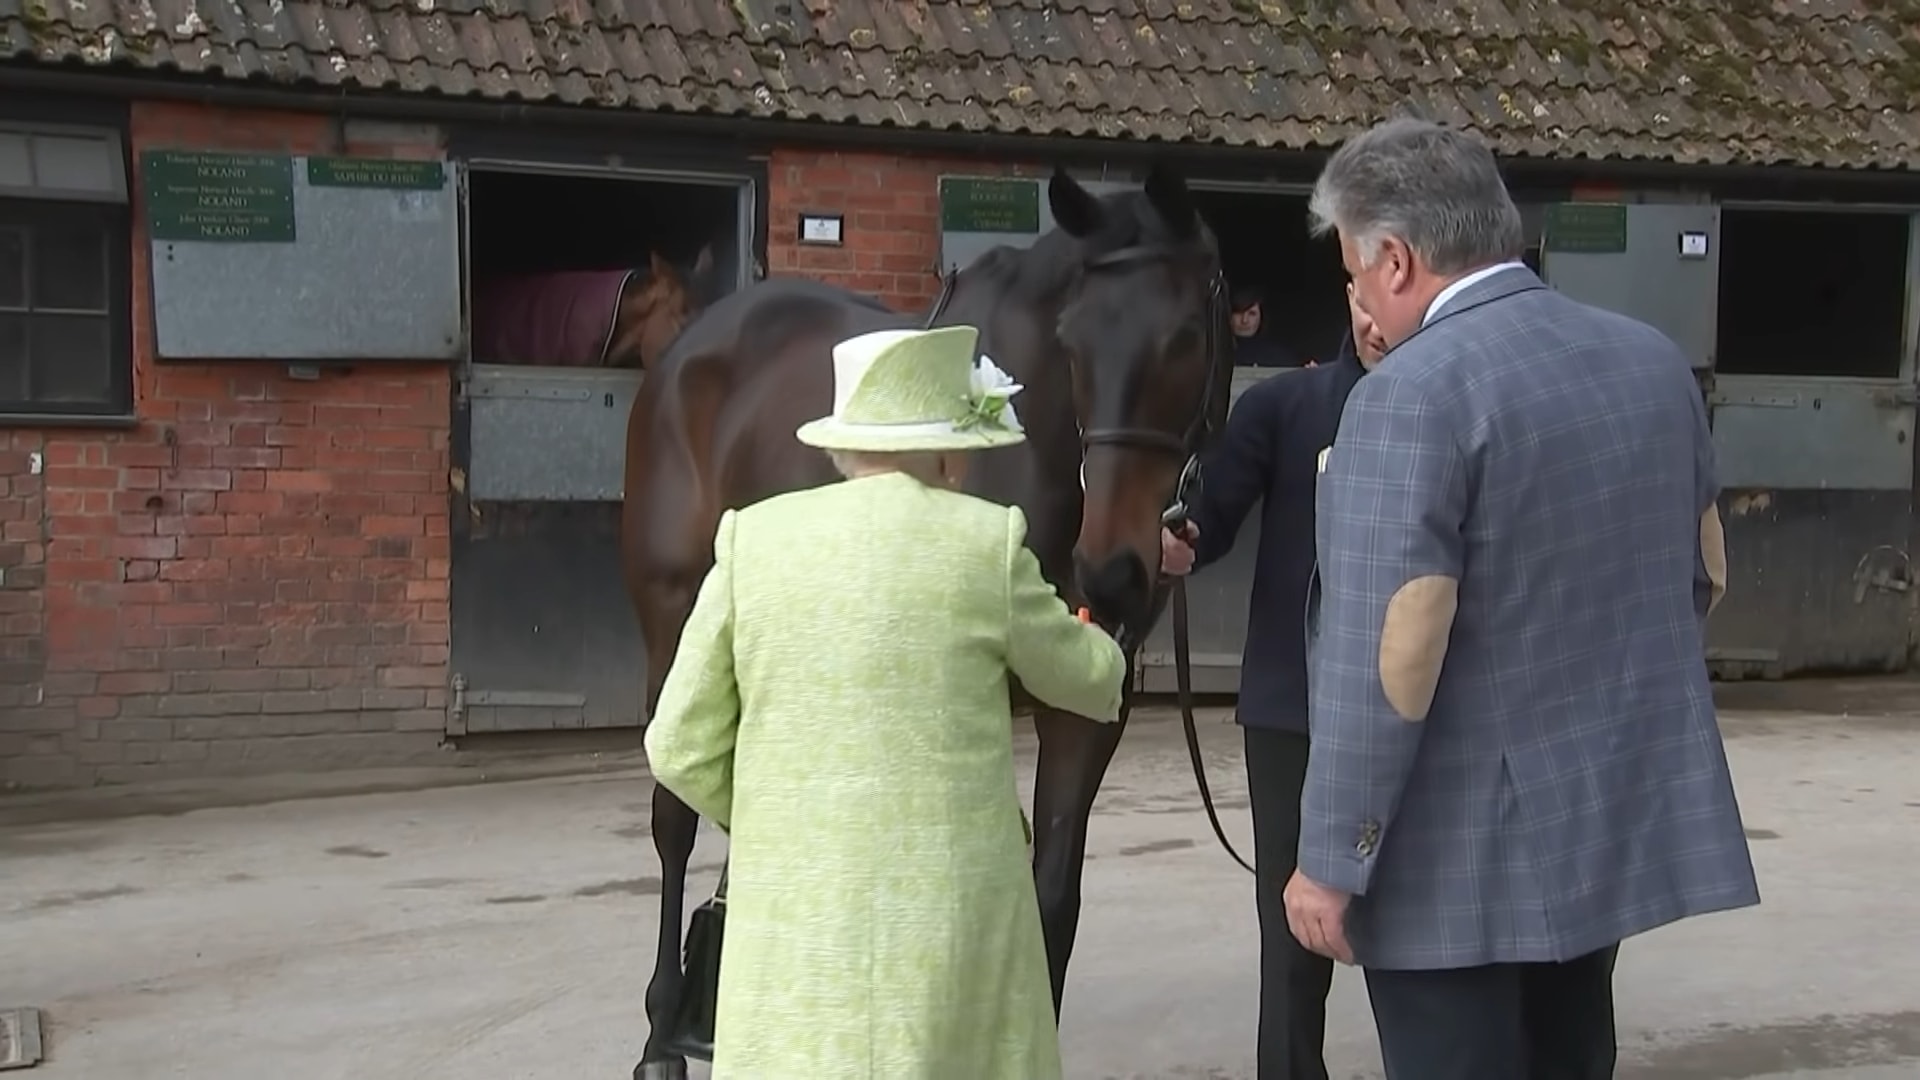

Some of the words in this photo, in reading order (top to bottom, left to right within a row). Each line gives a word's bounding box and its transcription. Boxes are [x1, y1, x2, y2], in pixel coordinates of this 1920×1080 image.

[197, 167, 246, 178] NOLAND
[198, 196, 248, 207] NOLAND
[201, 225, 249, 236] NOLAND
